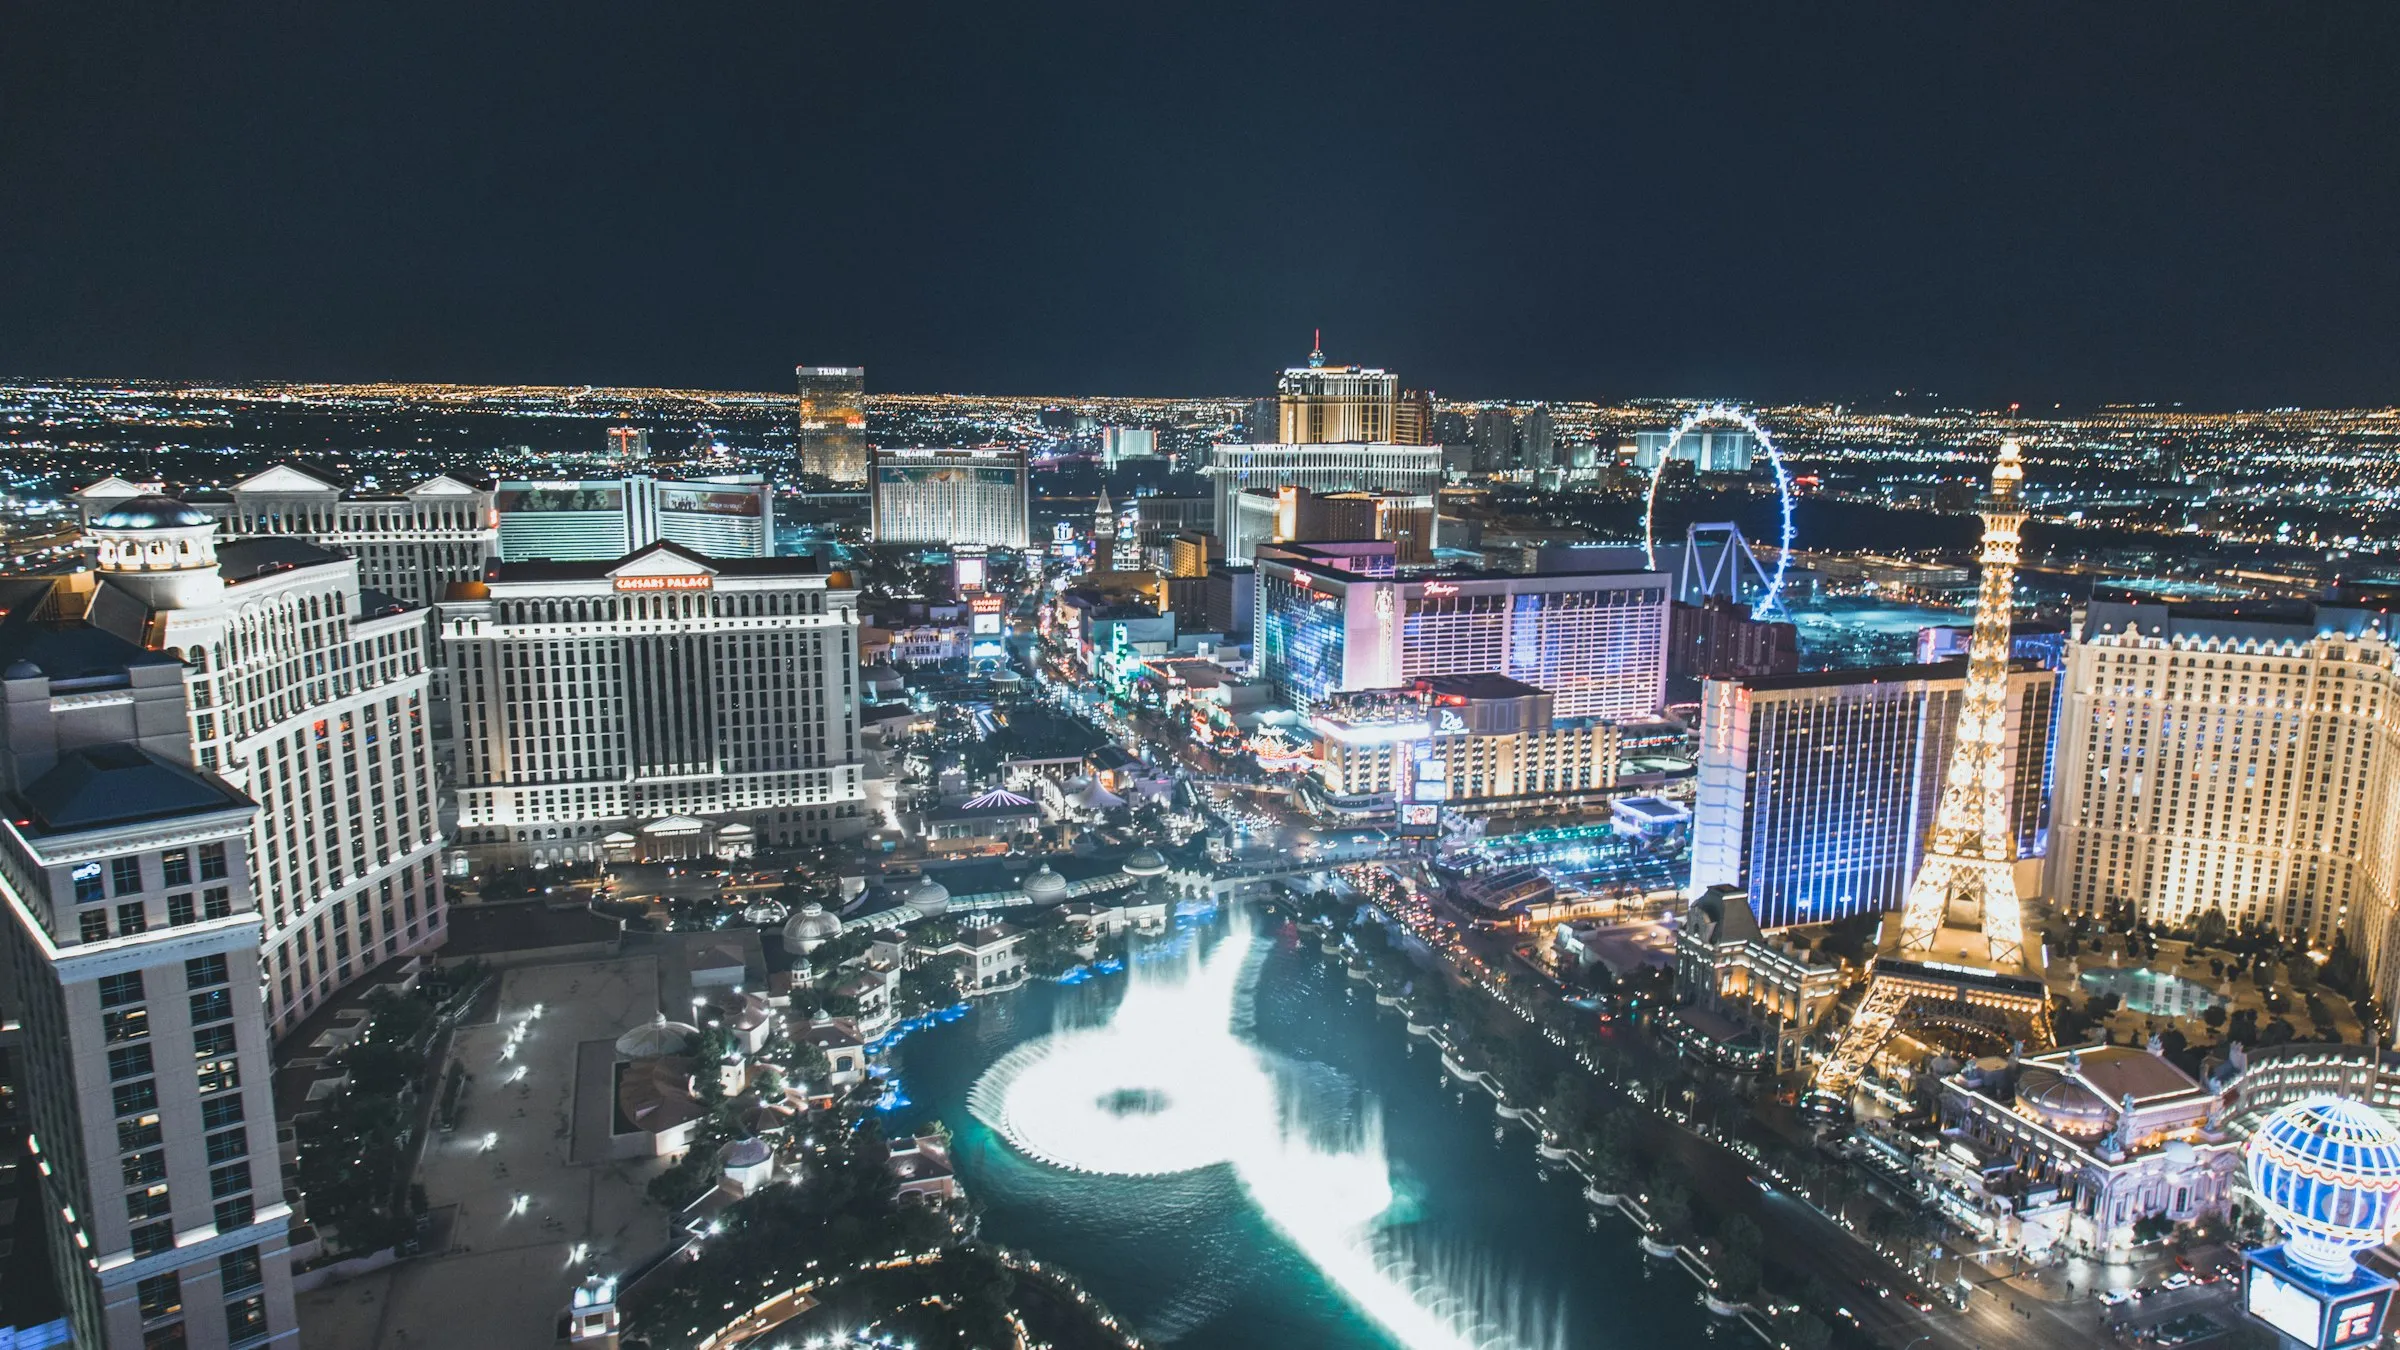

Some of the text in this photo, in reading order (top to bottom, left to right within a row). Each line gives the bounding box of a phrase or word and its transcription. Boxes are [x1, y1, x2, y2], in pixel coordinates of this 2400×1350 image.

[817, 367, 847, 375] TRUMP
[616, 577, 708, 588] CAESARS PALACE
